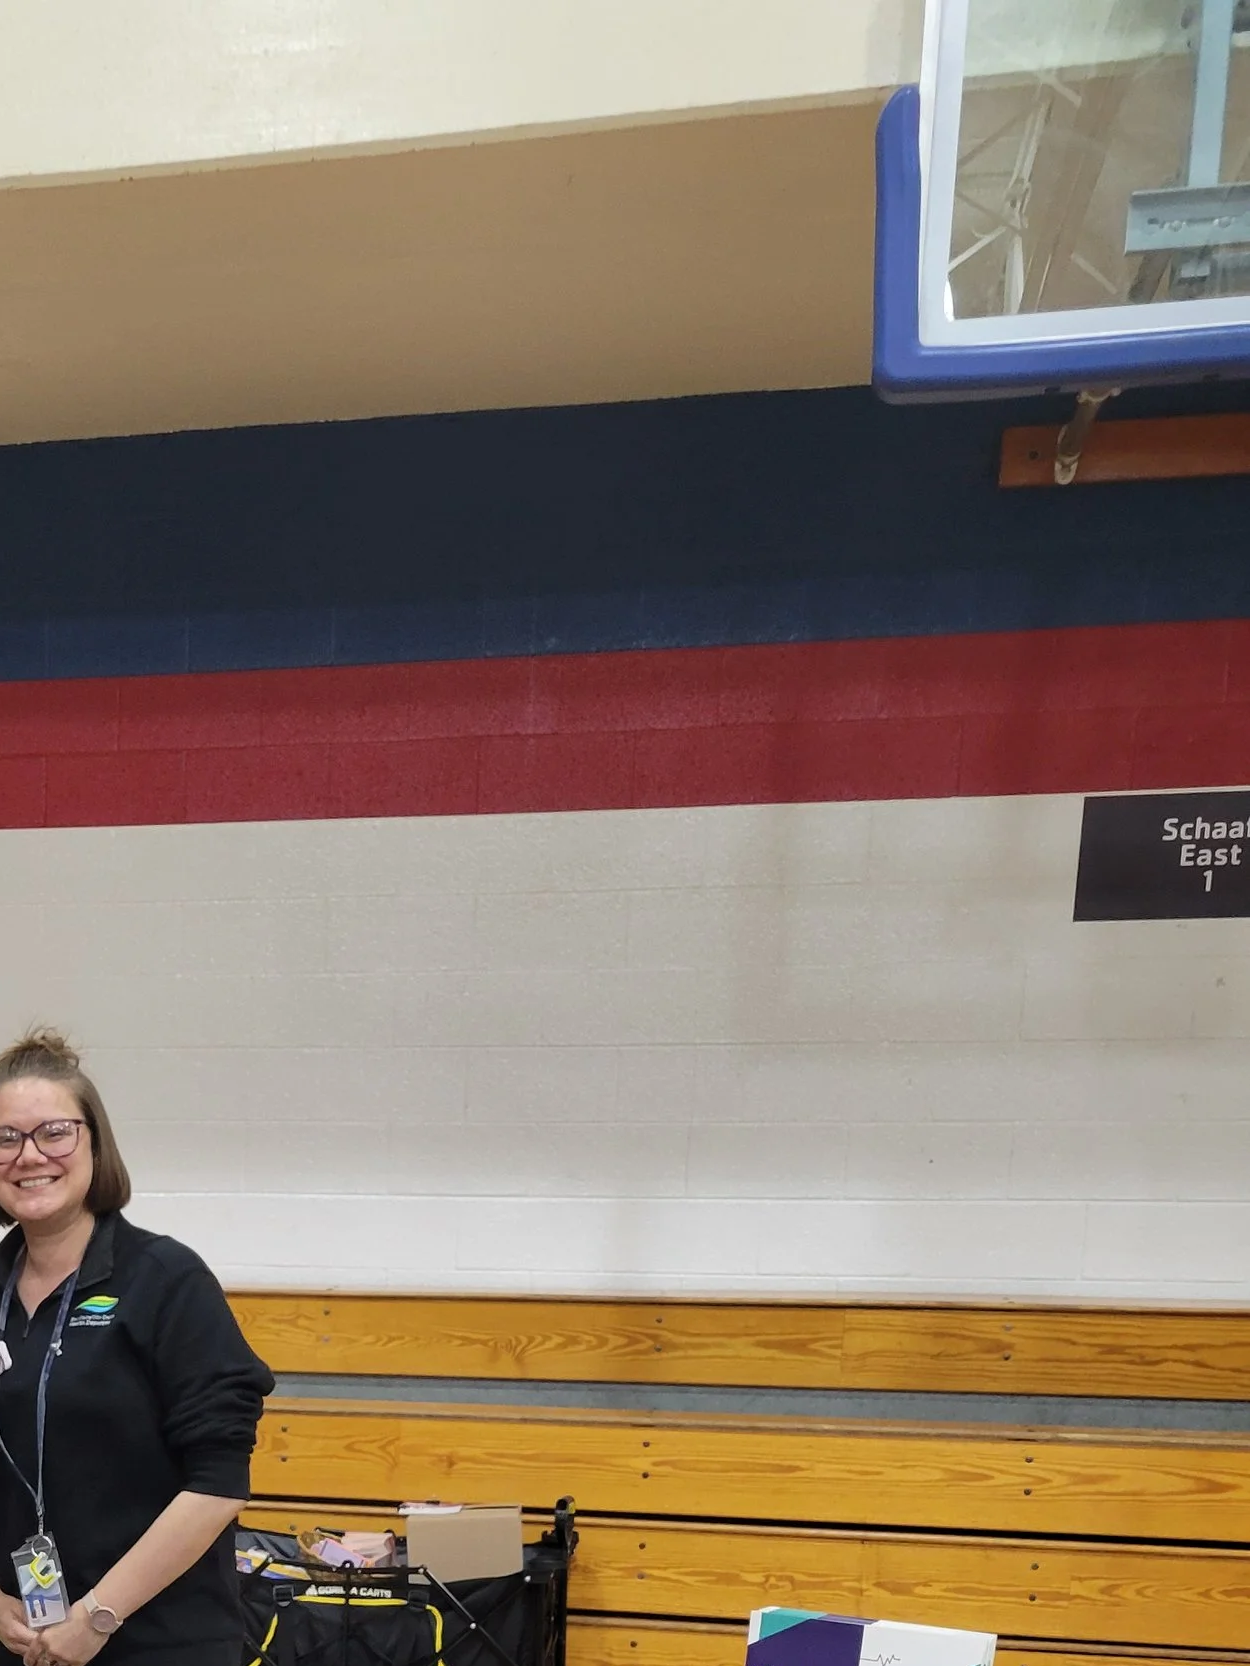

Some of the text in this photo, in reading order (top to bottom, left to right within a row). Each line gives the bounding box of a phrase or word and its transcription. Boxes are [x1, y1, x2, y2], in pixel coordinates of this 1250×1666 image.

[1162, 816, 1250, 841] Schaa
[1180, 844, 1242, 866] East
[1203, 870, 1213, 892] 1
[318, 1585, 392, 1598] GORILA CARTS
